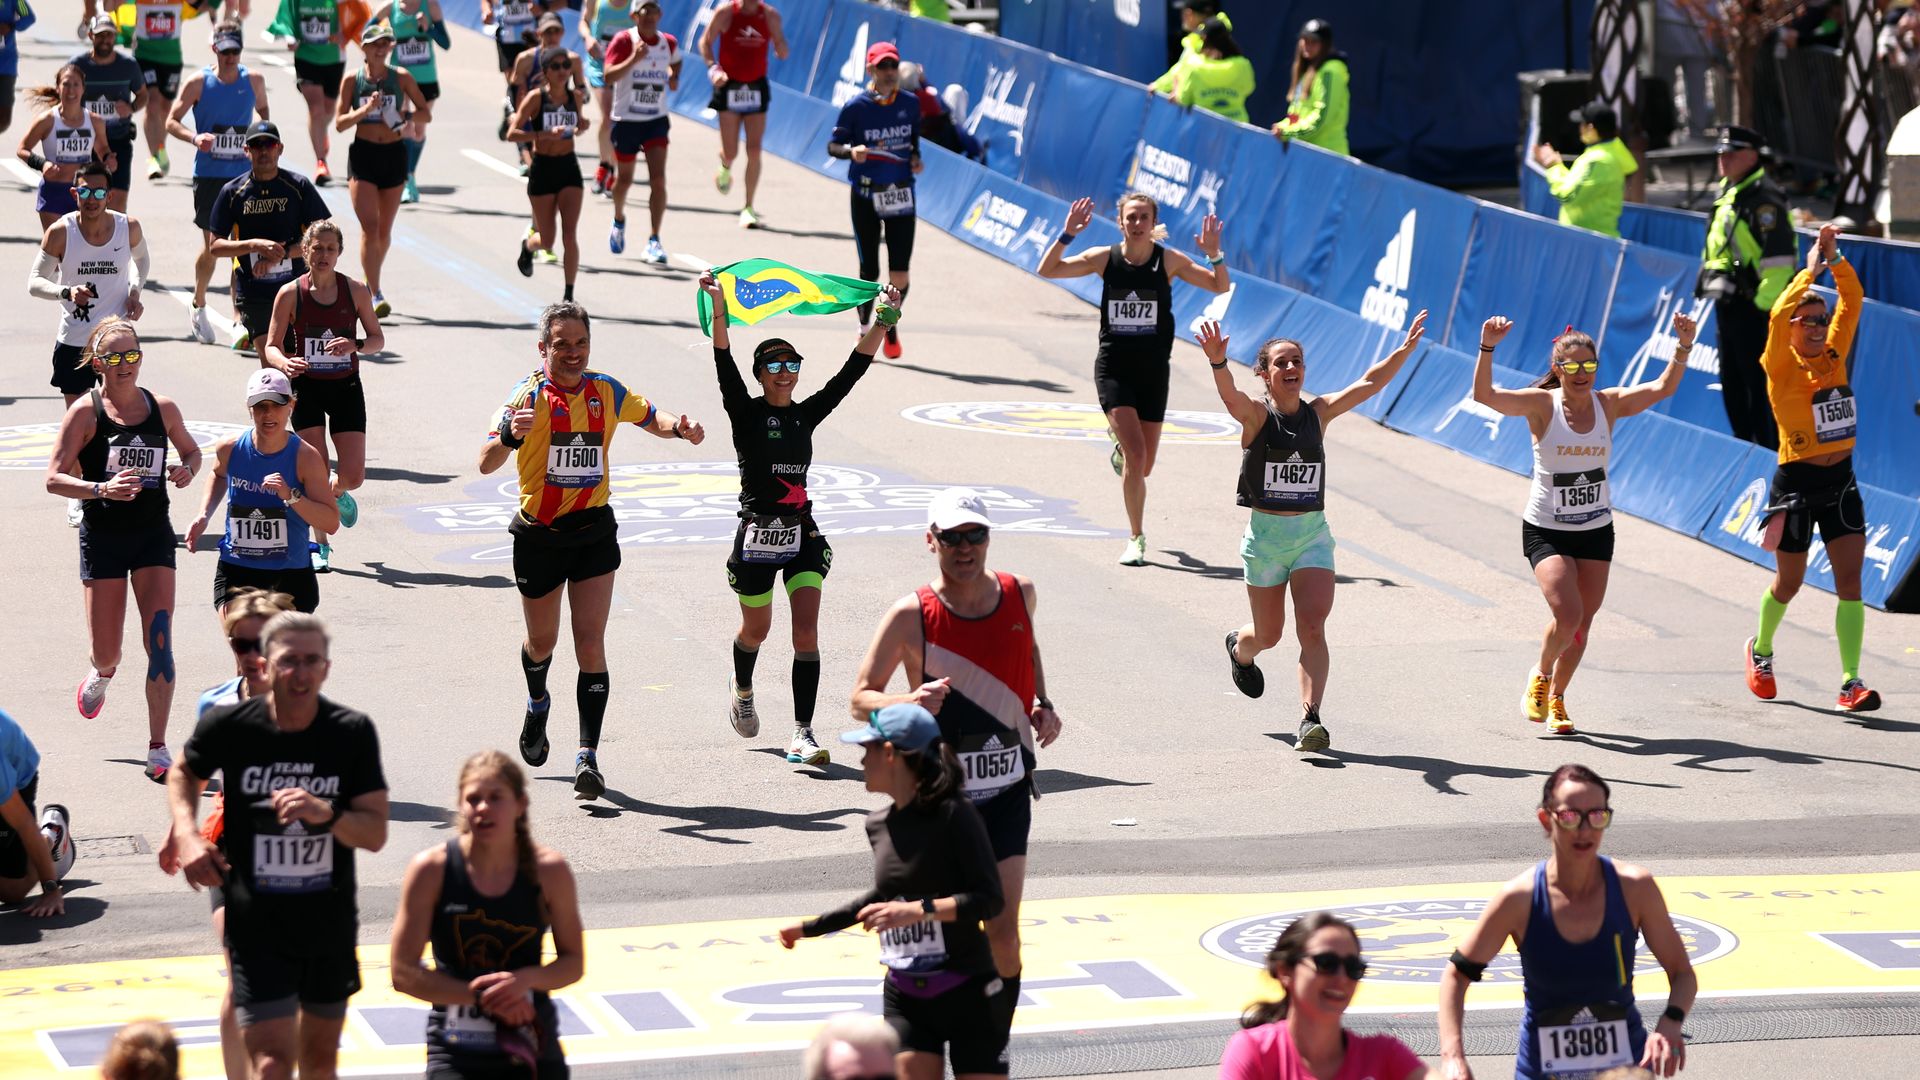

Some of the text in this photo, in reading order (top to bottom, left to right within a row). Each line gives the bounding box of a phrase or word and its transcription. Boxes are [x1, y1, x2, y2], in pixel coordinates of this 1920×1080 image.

[61, 138, 89, 151] 14312
[215, 134, 244, 148] 10142
[243, 198, 288, 215] NAVY
[77, 267, 118, 276] HARRIERS
[1114, 302, 1153, 318] 14872
[1818, 399, 1855, 424] 15508
[118, 448, 155, 468] 8960
[556, 447, 598, 468] 11500
[1556, 445, 1606, 456] TABATA
[772, 463, 807, 474] PRISCILA
[1271, 464, 1317, 484] 14627
[1560, 483, 1602, 507] 13567
[236, 520, 280, 540] 11491
[752, 528, 797, 546] 13025
[273, 762, 315, 774] TEAM
[964, 749, 1018, 779] 10557
[241, 765, 340, 797] Gleason
[264, 837, 327, 865] 11127
[1679, 889, 1885, 900] 126TH
[886, 920, 936, 946] 10304
[2, 975, 174, 996] 26TH
[1549, 1024, 1619, 1059] 13981
